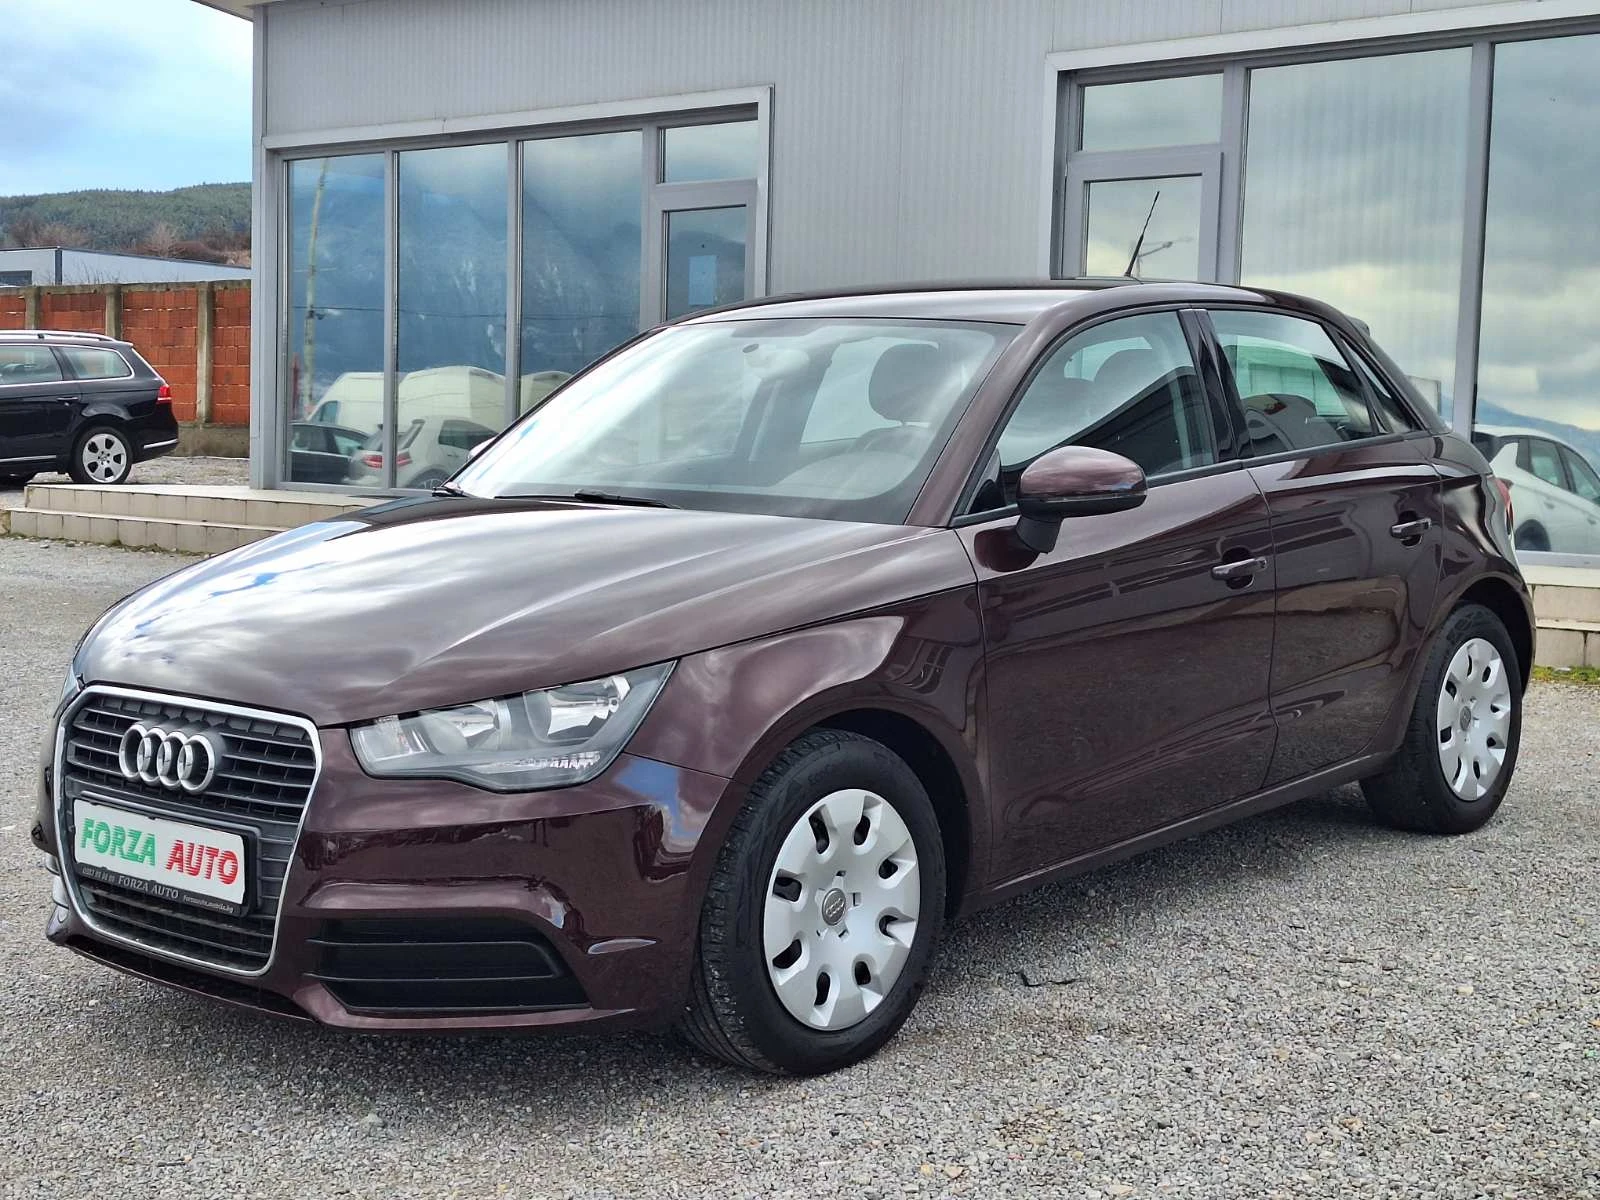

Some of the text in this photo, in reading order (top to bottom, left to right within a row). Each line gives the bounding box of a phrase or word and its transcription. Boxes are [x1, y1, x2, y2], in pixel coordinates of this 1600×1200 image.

[80, 817, 239, 885] FORZA AUTO
[118, 875, 148, 892] FORZA
[151, 884, 179, 899] AUTO
